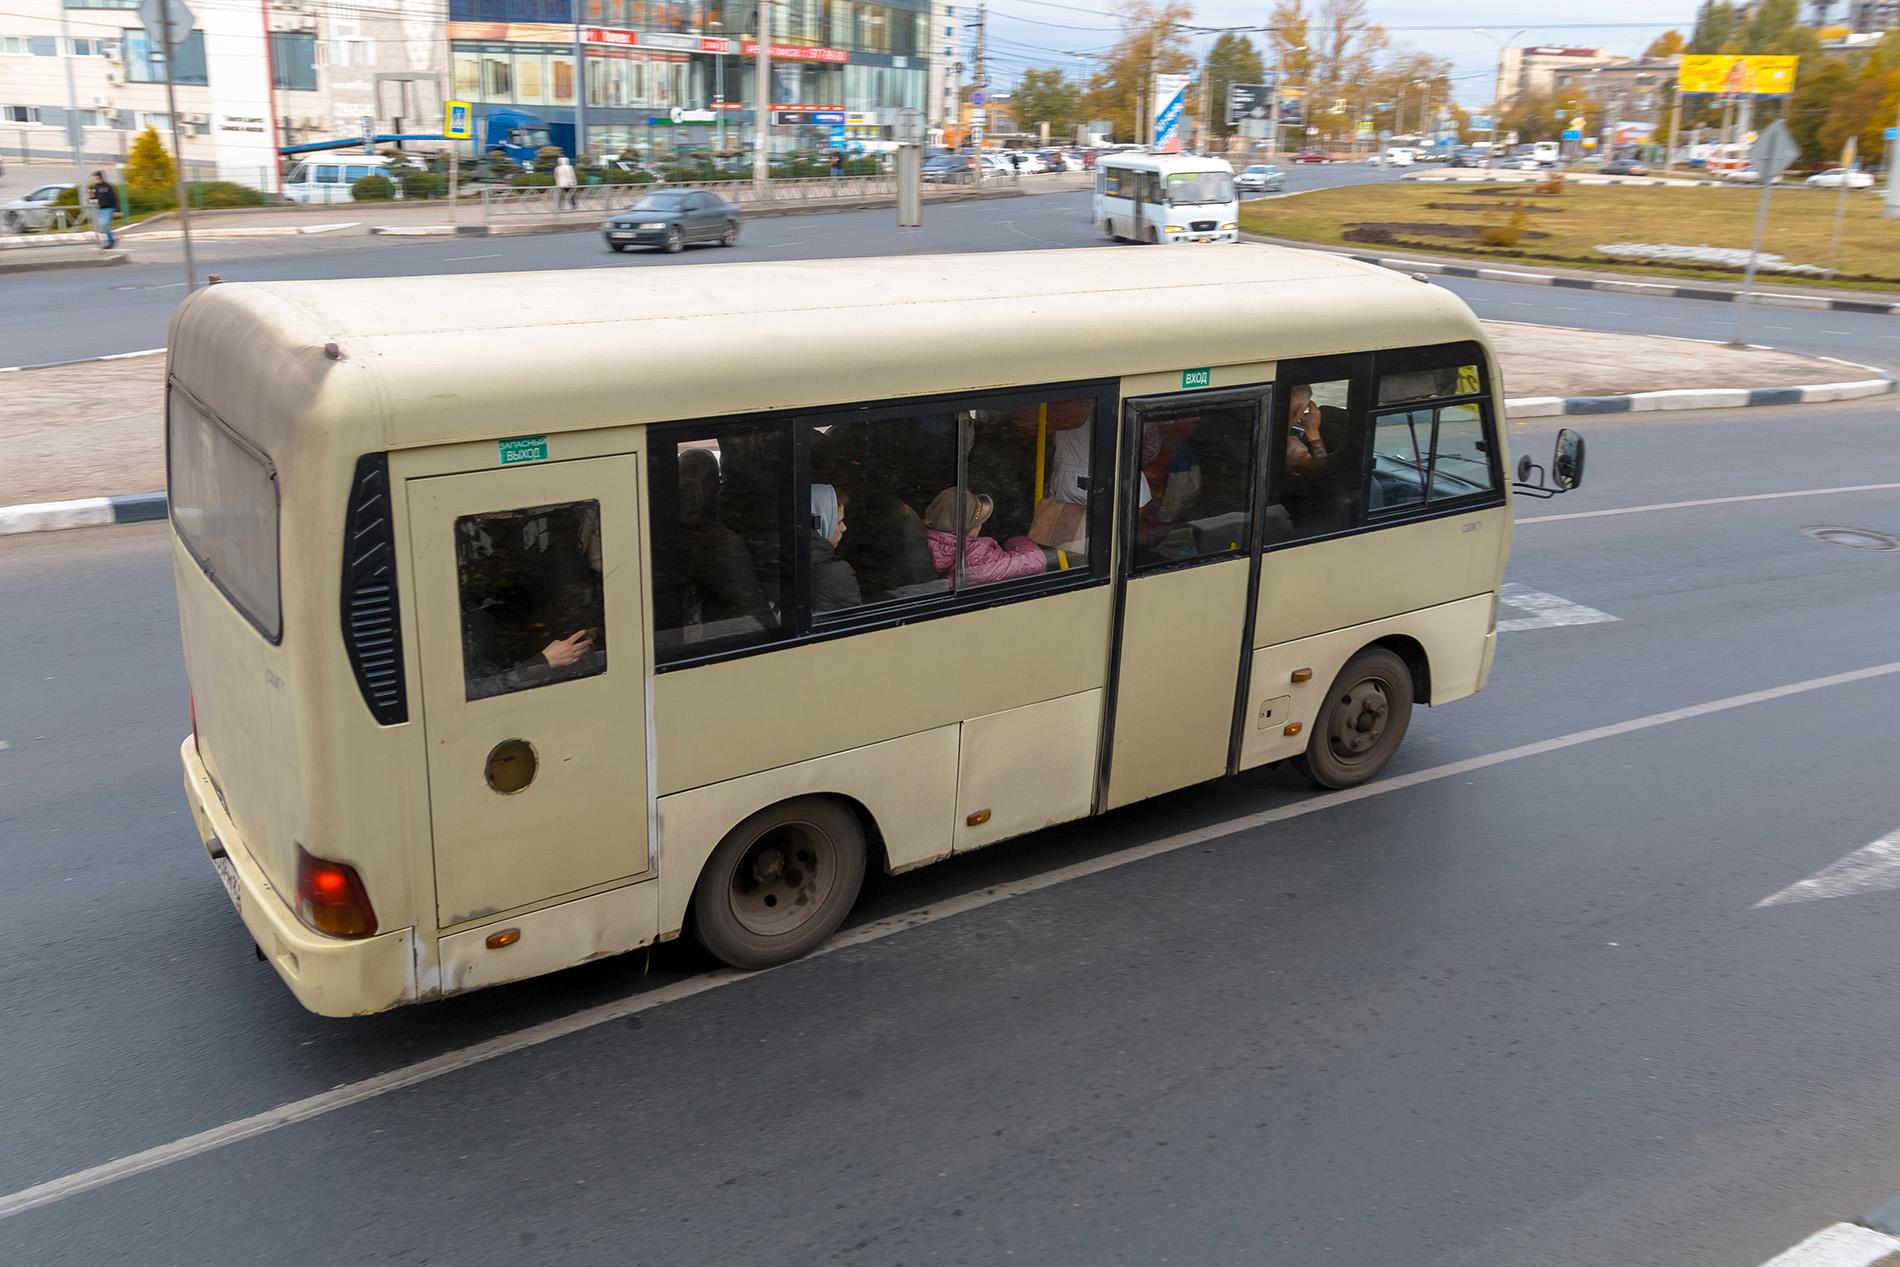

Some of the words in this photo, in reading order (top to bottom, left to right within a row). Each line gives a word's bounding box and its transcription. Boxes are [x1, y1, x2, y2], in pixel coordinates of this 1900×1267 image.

[1186, 372, 1207, 384] ВХОД
[500, 437, 545, 449] ЗАПАСНЫЙ
[507, 448, 540, 461] ВЫХОД
